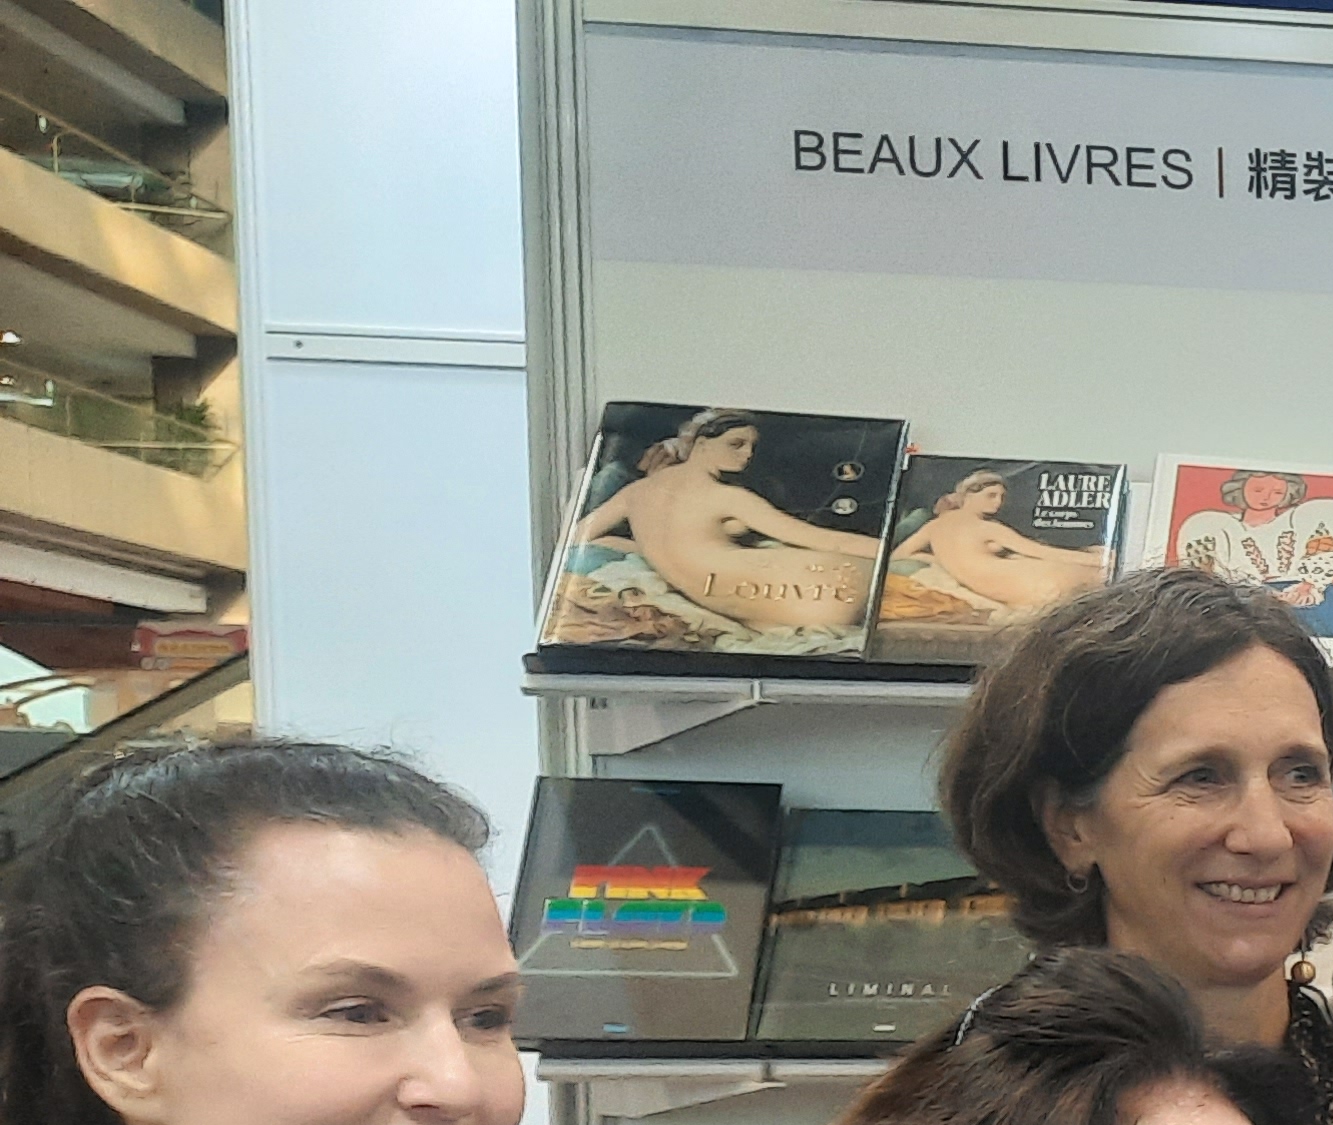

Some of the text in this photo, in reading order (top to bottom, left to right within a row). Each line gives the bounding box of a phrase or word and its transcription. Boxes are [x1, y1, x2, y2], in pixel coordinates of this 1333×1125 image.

[794, 129, 1194, 190] BEAUX LIVRES
[1039, 473, 1111, 491] LAURE
[1037, 490, 1111, 508] ADLER
